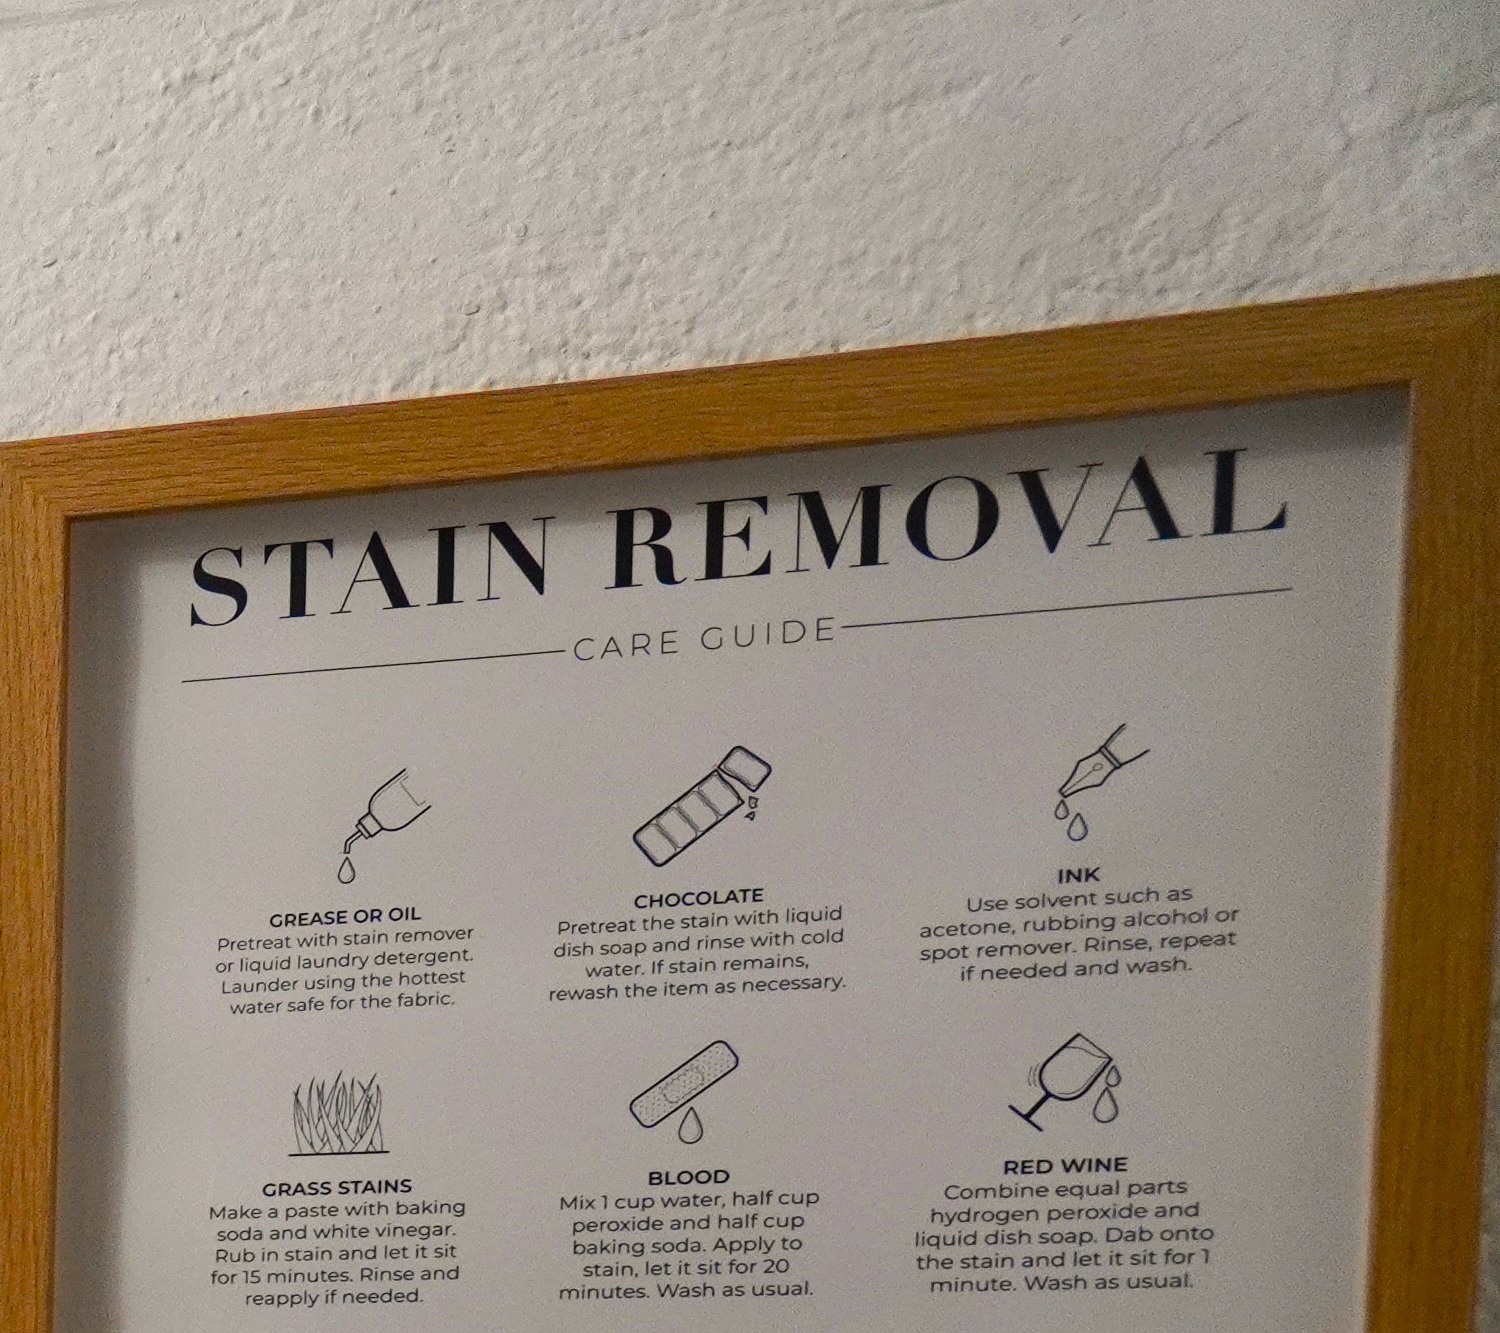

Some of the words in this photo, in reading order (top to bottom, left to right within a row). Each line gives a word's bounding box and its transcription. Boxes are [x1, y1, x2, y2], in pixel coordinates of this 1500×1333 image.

[189, 515, 556, 628] STAIN
[604, 447, 1289, 591] REMOVAL
[573, 626, 680, 663] CARE
[700, 616, 836, 651] GUIDE
[1057, 866, 1101, 884] INK
[633, 887, 764, 910] CHOCOLATE
[966, 897, 1009, 913] Use
[1014, 892, 1097, 910] solvent
[1104, 886, 1160, 905] such
[1166, 888, 1193, 901] as
[268, 909, 348, 928] GREASE
[353, 908, 383, 924] OR
[387, 906, 422, 922] OIL
[919, 921, 1016, 938] acetone,
[1023, 913, 1116, 932] rubbing
[1122, 906, 1208, 928] alcohol
[1214, 909, 1240, 923] or
[217, 935, 292, 952] Pretreat
[296, 932, 338, 948] with
[343, 929, 389, 946] stain
[394, 927, 474, 943] remover
[919, 945, 969, 964] spot
[976, 941, 1077, 958] remover.
[1084, 936, 1152, 952] Rinse,
[1159, 931, 1237, 951] repeat
[214, 961, 234, 974] or
[239, 955, 291, 974] liquid
[297, 952, 369, 970] laundry
[373, 948, 473, 967] detergent.
[960, 965, 975, 981] if
[980, 961, 1067, 981] needed
[1073, 959, 1119, 977] and
[1126, 956, 1192, 974] wash.
[221, 977, 299, 995] Launder
[304, 975, 356, 992] using
[361, 972, 393, 988] the
[398, 970, 466, 986] hottest
[229, 1001, 283, 1015] water
[286, 996, 325, 1012] safe
[329, 995, 355, 1010] for
[360, 994, 392, 1009] the
[397, 991, 455, 1007] fabric.
[647, 1169, 730, 1186] BLOOD
[1003, 1158, 1054, 1175] RED
[1060, 1156, 1129, 1174] WINE
[261, 1180, 332, 1197] GRASS
[337, 1178, 413, 1195] STAINS
